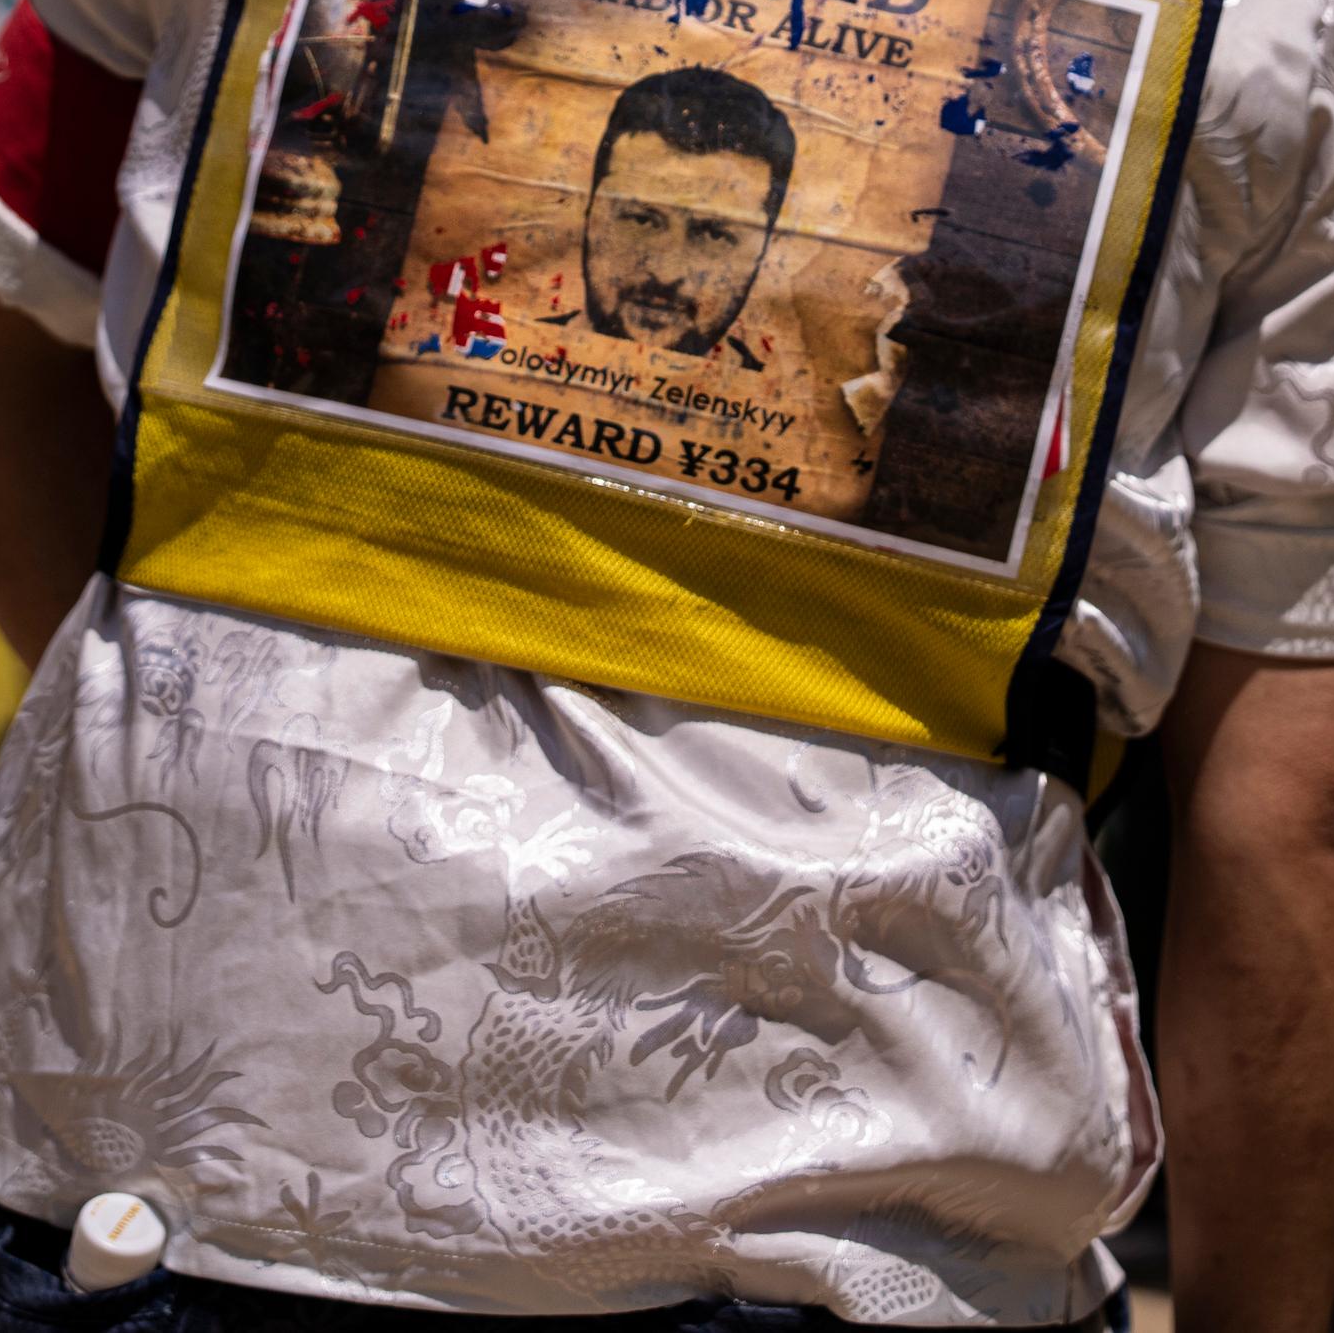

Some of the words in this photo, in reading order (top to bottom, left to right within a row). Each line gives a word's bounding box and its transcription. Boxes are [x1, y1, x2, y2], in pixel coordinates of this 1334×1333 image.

[770, 10, 916, 68] ALIVE
[499, 346, 638, 395] olodymyr
[650, 375, 797, 437] Zelenskyy
[441, 384, 663, 466] REWARD
[677, 439, 803, 502] ¥334
